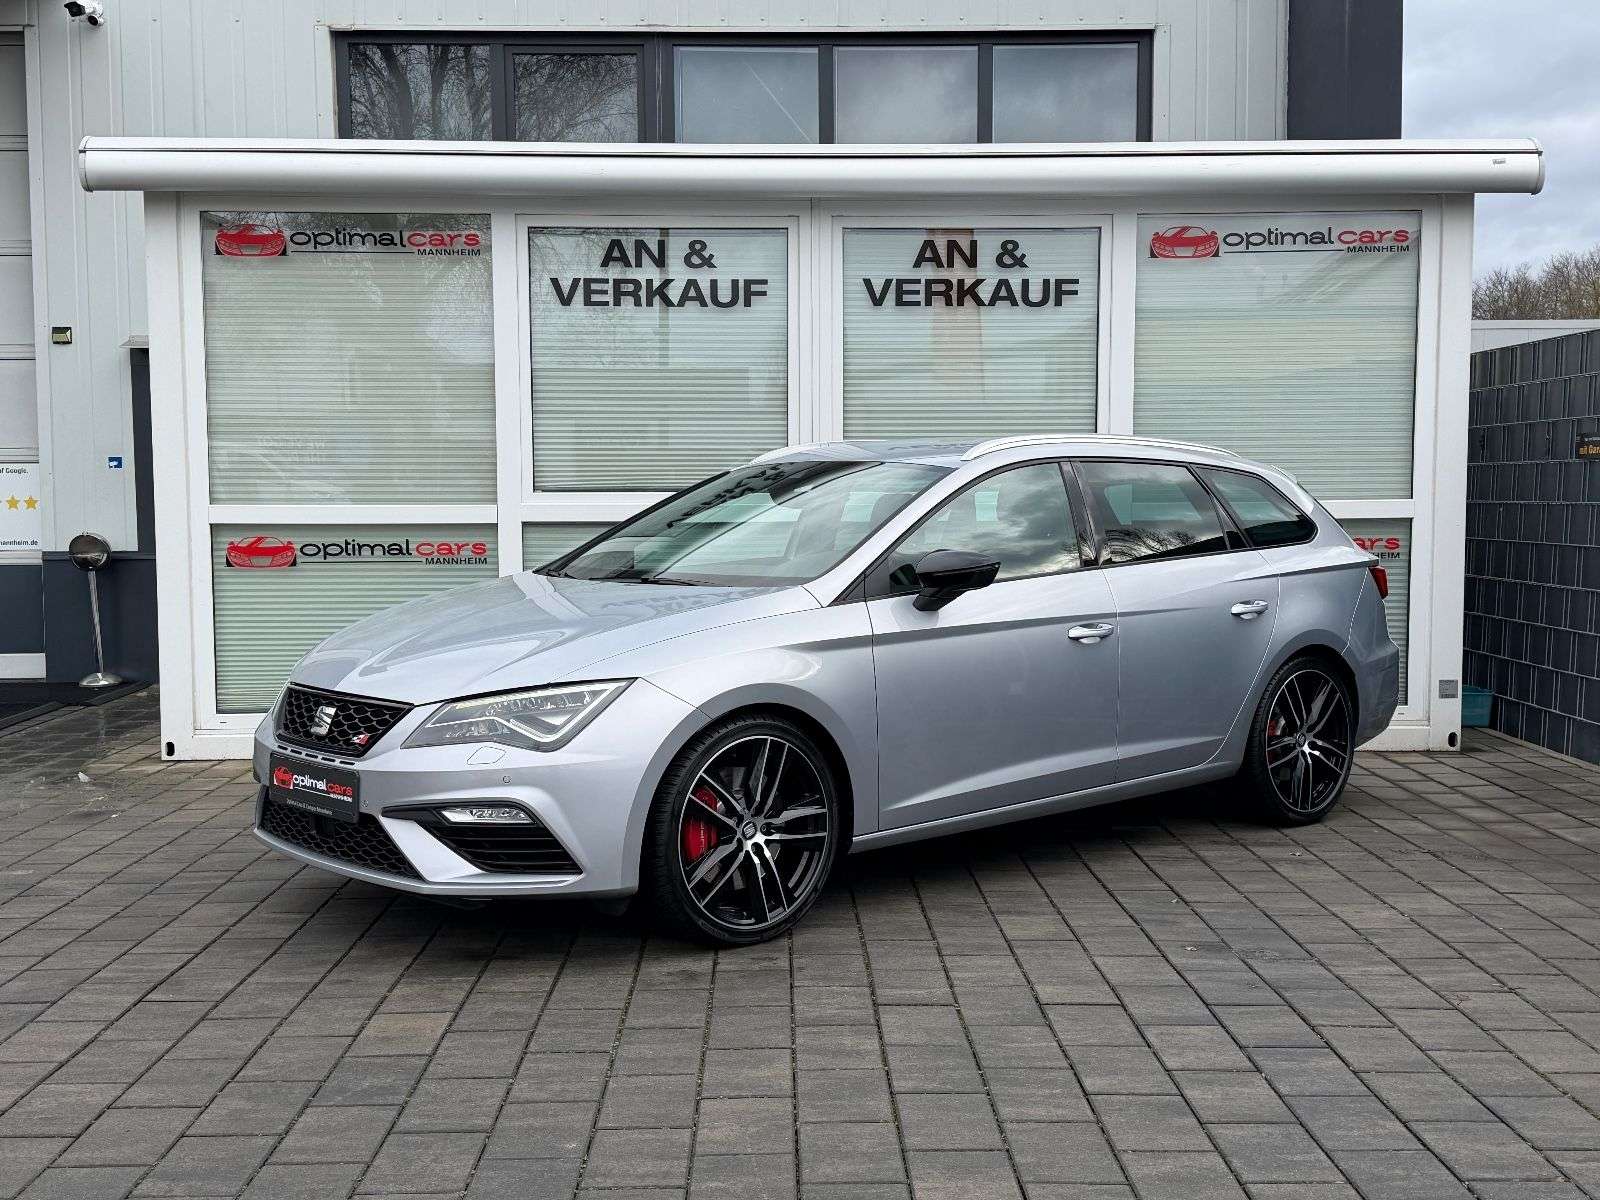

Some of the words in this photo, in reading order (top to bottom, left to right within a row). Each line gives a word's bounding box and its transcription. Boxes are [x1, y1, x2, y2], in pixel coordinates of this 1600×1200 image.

[417, 248, 481, 257] MANNHEIM
[600, 239, 666, 268] AN
[683, 239, 717, 269] &
[912, 239, 978, 269] AN
[995, 239, 1029, 269] &
[1347, 245, 1410, 253] MANNHEIM
[549, 277, 768, 309] VERKAUF
[862, 277, 1079, 308] VERKAUF
[1352, 537, 1400, 551] ars
[425, 557, 487, 565] MANNHEIM
